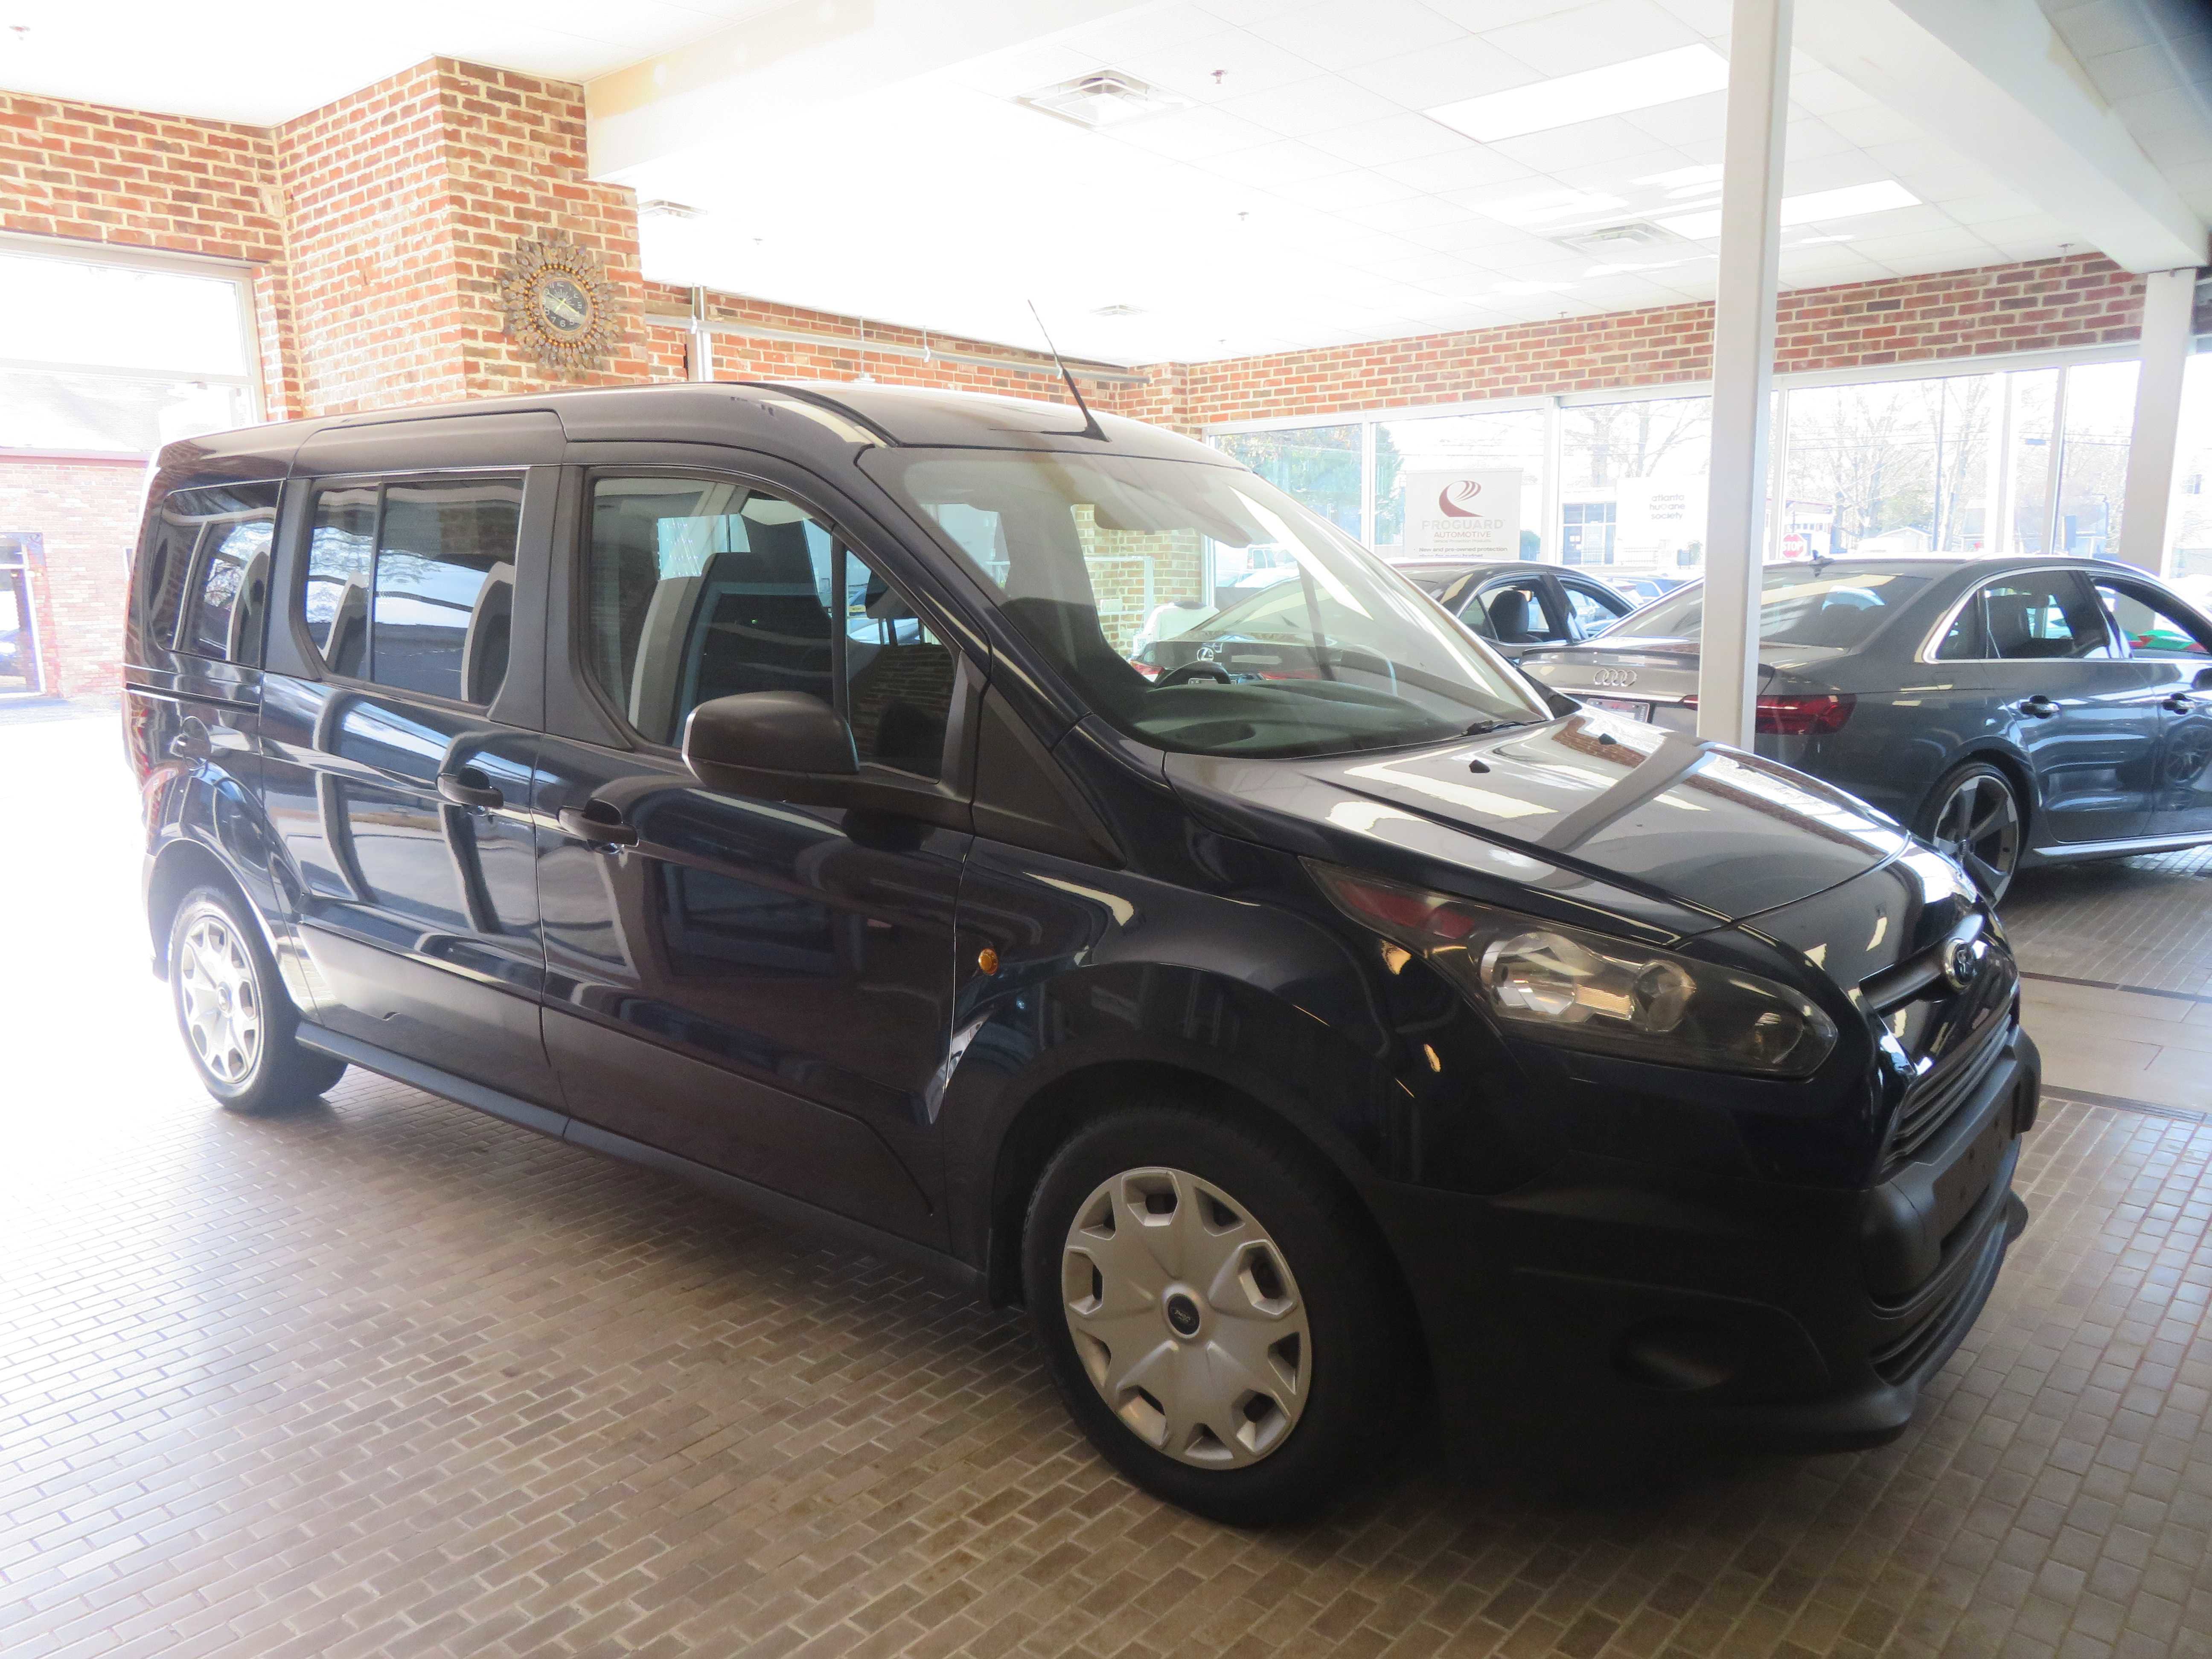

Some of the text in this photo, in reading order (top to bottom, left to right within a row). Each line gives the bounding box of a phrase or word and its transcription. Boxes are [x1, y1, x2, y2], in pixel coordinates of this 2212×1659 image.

[544, 307, 550, 316] 8
[569, 317, 574, 326] 5
[1651, 493, 1685, 501] atlanta
[1651, 511, 1683, 520] society
[1422, 519, 1503, 530] PROGUARD
[1782, 541, 1803, 551] STOP
